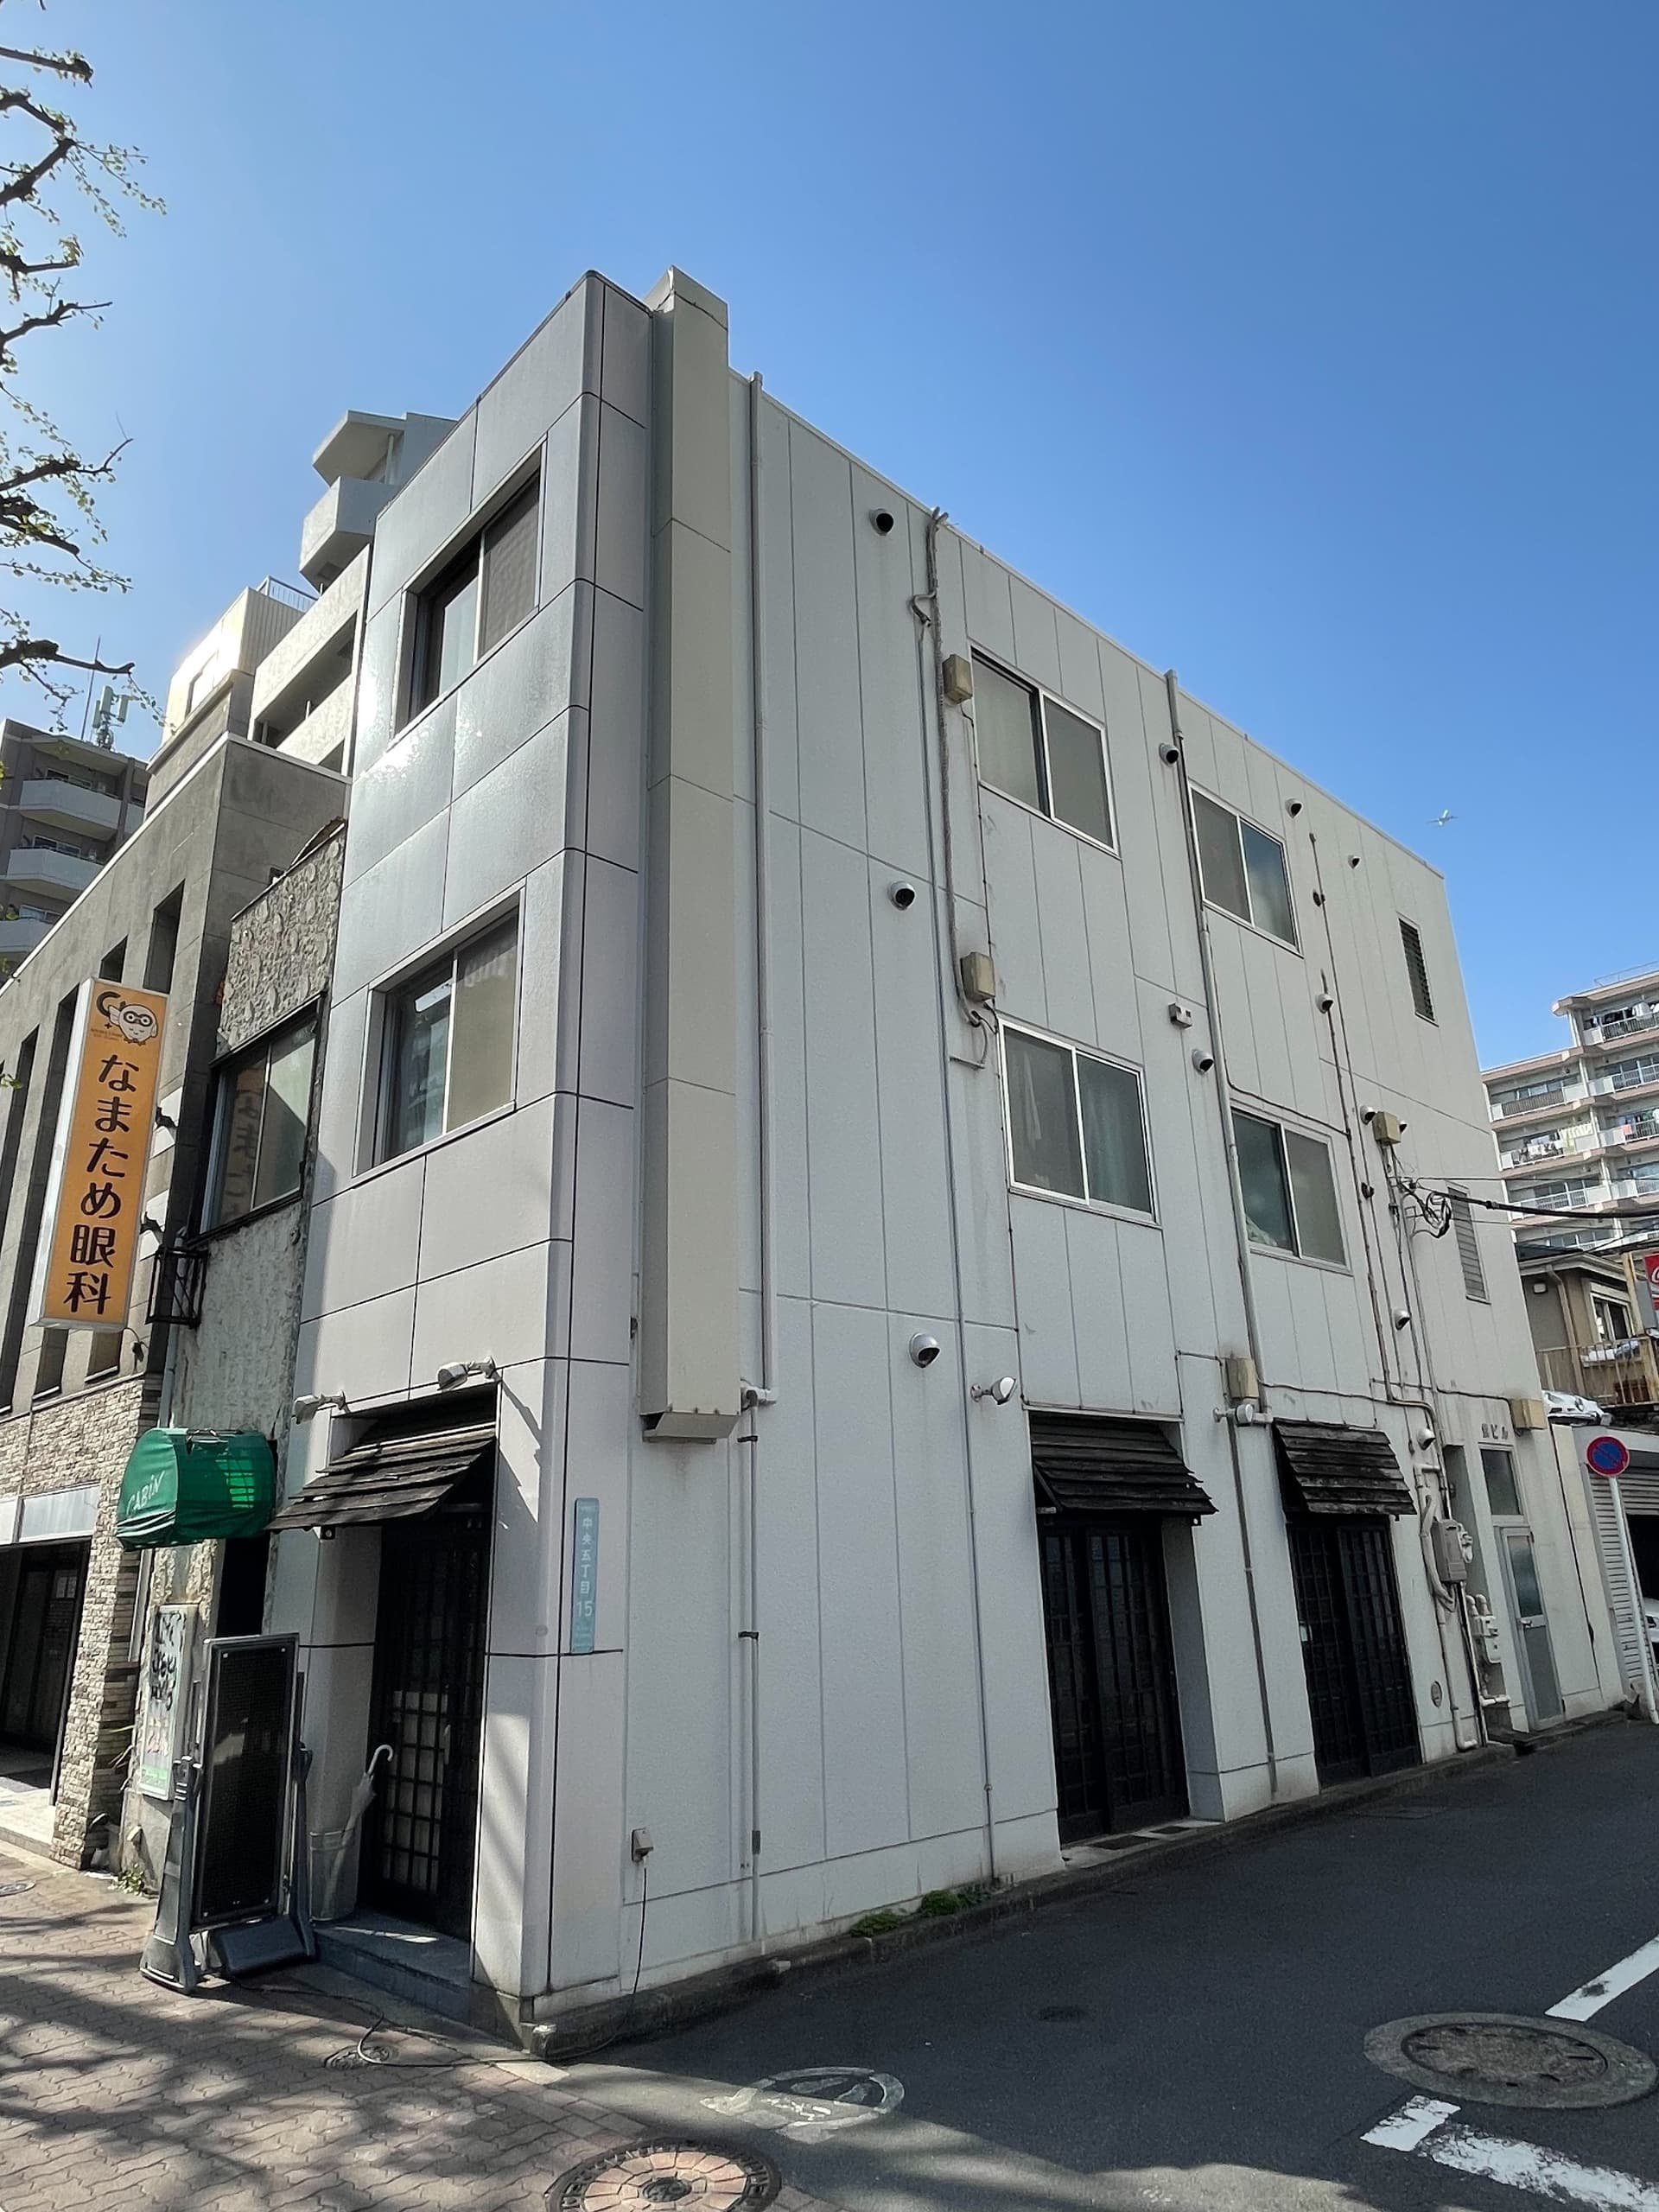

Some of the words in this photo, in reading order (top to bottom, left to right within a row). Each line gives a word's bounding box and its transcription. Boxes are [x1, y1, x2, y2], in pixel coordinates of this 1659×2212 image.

[63, 1054, 139, 1315] なまため眼科
